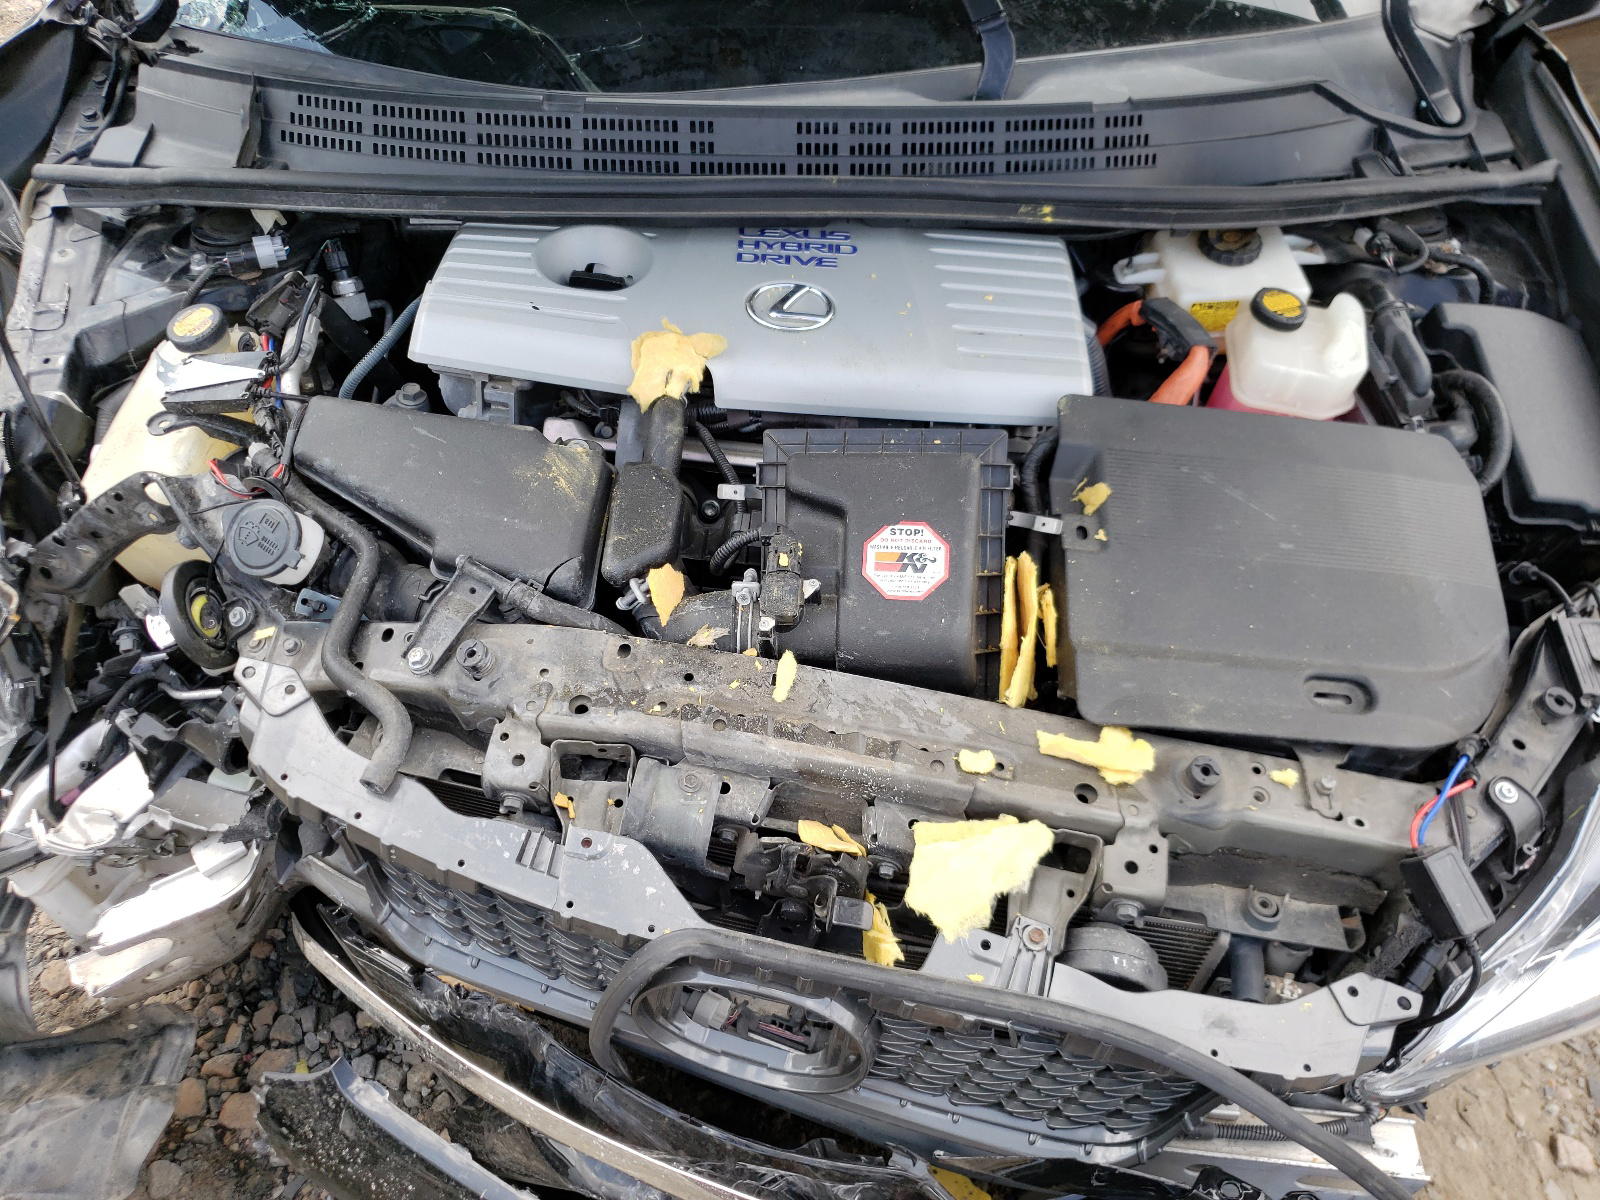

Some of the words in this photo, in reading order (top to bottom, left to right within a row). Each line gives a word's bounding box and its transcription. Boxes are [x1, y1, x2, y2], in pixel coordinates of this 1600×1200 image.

[738, 227, 851, 241] LEXUS
[737, 240, 858, 254] HYBRID
[736, 252, 839, 268] DRIVE
[889, 528, 924, 536] STOP!
